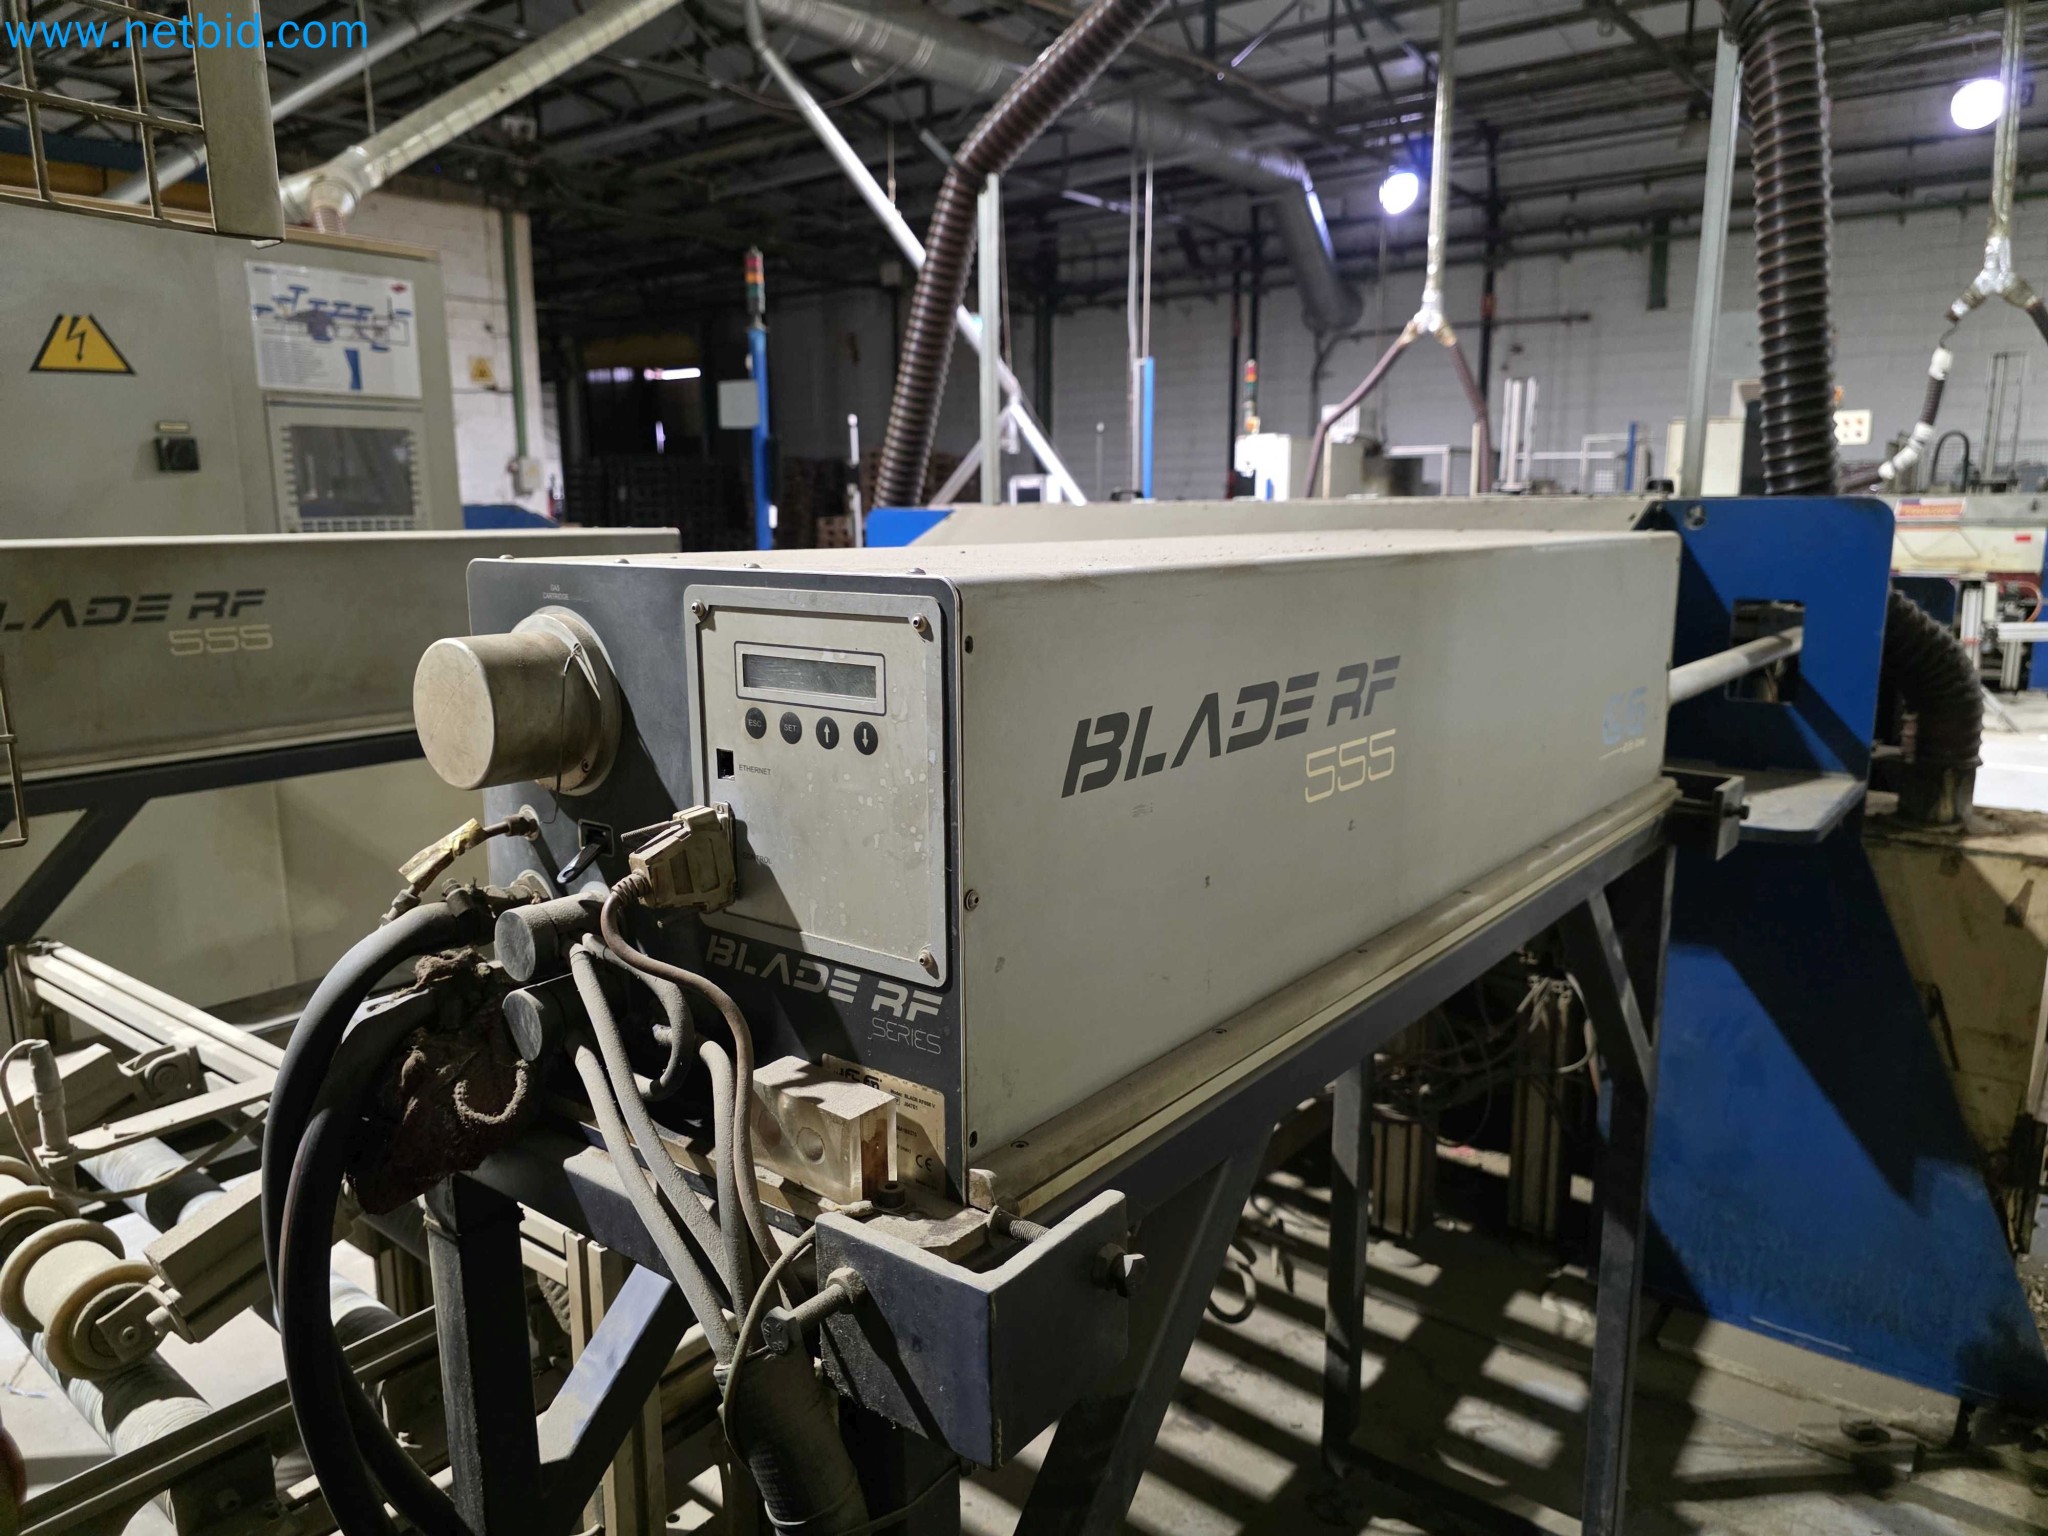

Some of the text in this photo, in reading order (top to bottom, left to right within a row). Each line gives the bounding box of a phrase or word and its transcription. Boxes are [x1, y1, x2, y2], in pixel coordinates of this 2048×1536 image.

[188, 589, 267, 621] RF
[169, 624, 274, 656] 555
[748, 718, 762, 728] ESC
[783, 723, 797, 733] SET
[1061, 655, 1401, 799] BLADE RF
[738, 764, 771, 776] ETHERNET
[1304, 728, 1397, 803] 555
[742, 851, 772, 865] CONTROL
[705, 934, 943, 1022] BLADE RF
[871, 1016, 942, 1055] SERIES
